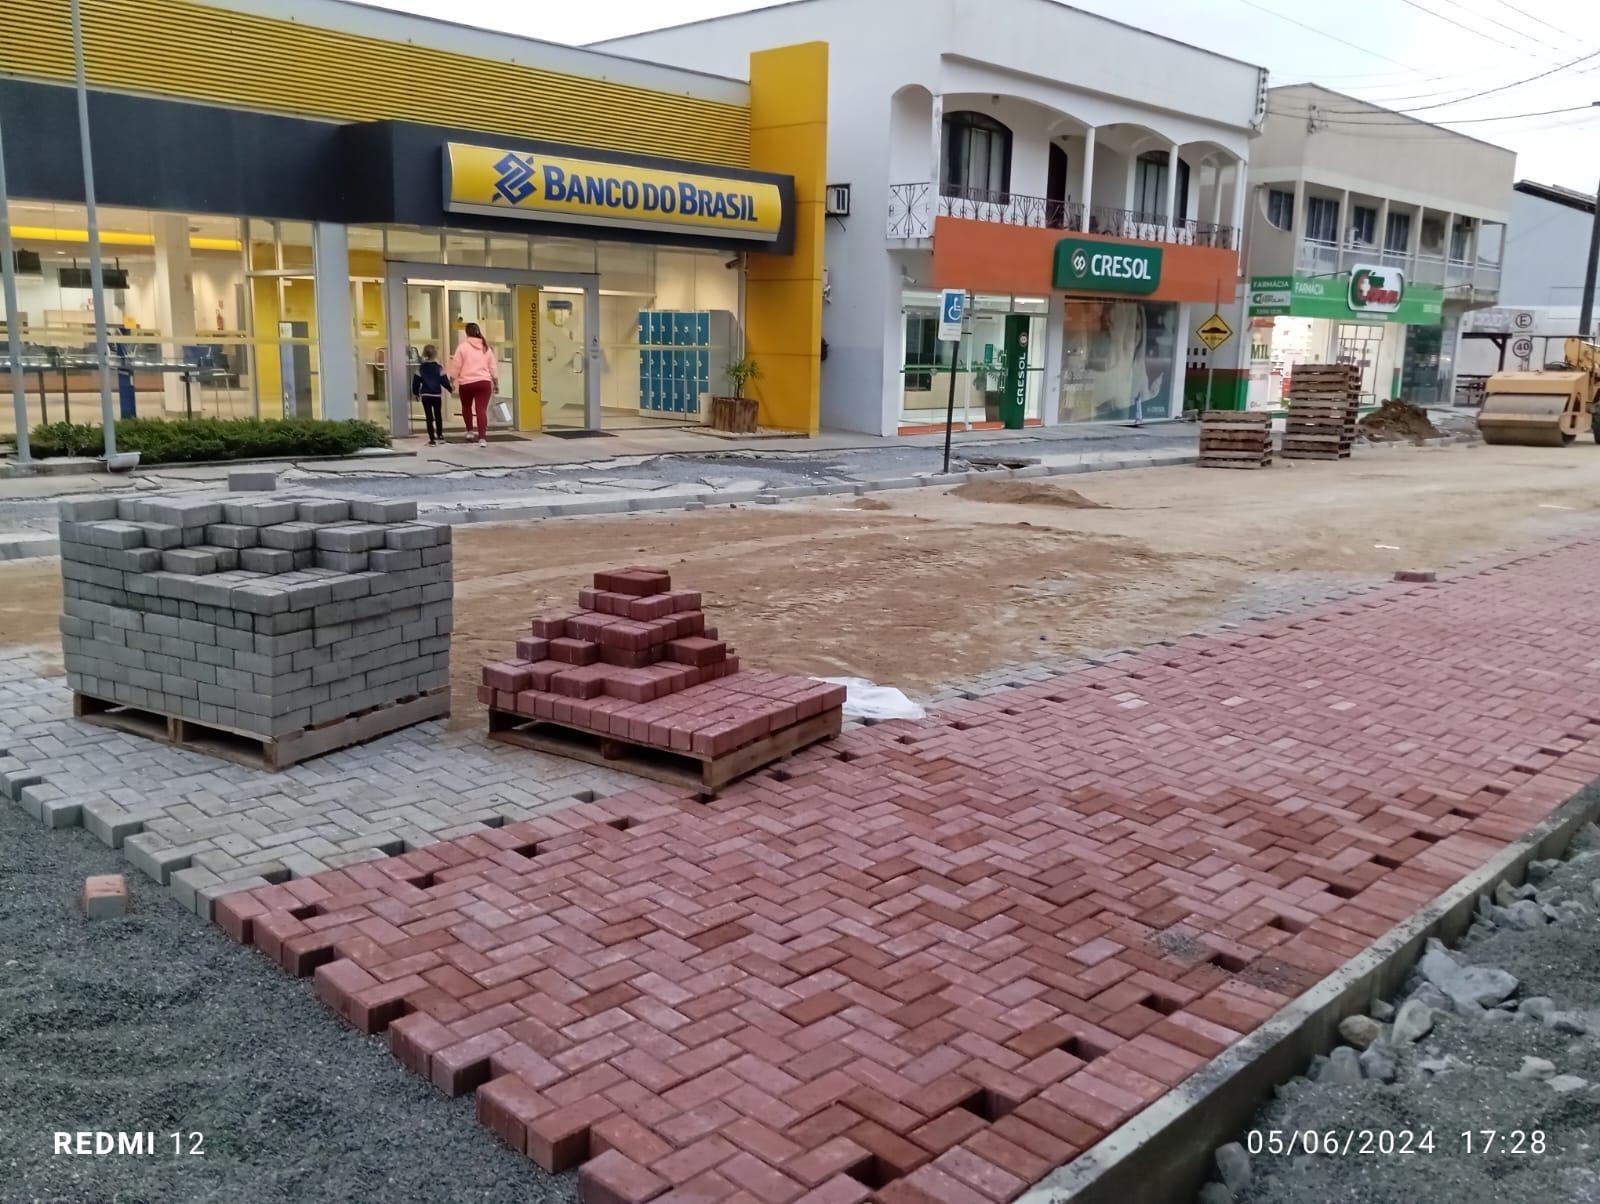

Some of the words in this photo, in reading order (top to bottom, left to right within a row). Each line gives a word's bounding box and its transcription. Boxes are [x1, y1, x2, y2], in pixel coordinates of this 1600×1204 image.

[543, 164, 639, 210] BANCO
[642, 182, 677, 214] DO
[678, 181, 759, 222] BRASIL
[1091, 254, 1151, 280] CRESOL
[1253, 280, 1289, 289] FARMÁCIA
[1519, 315, 1528, 327] E
[530, 302, 538, 394] Autoatendimento
[1516, 342, 1530, 352] 40
[1016, 352, 1027, 406] CRESOL
